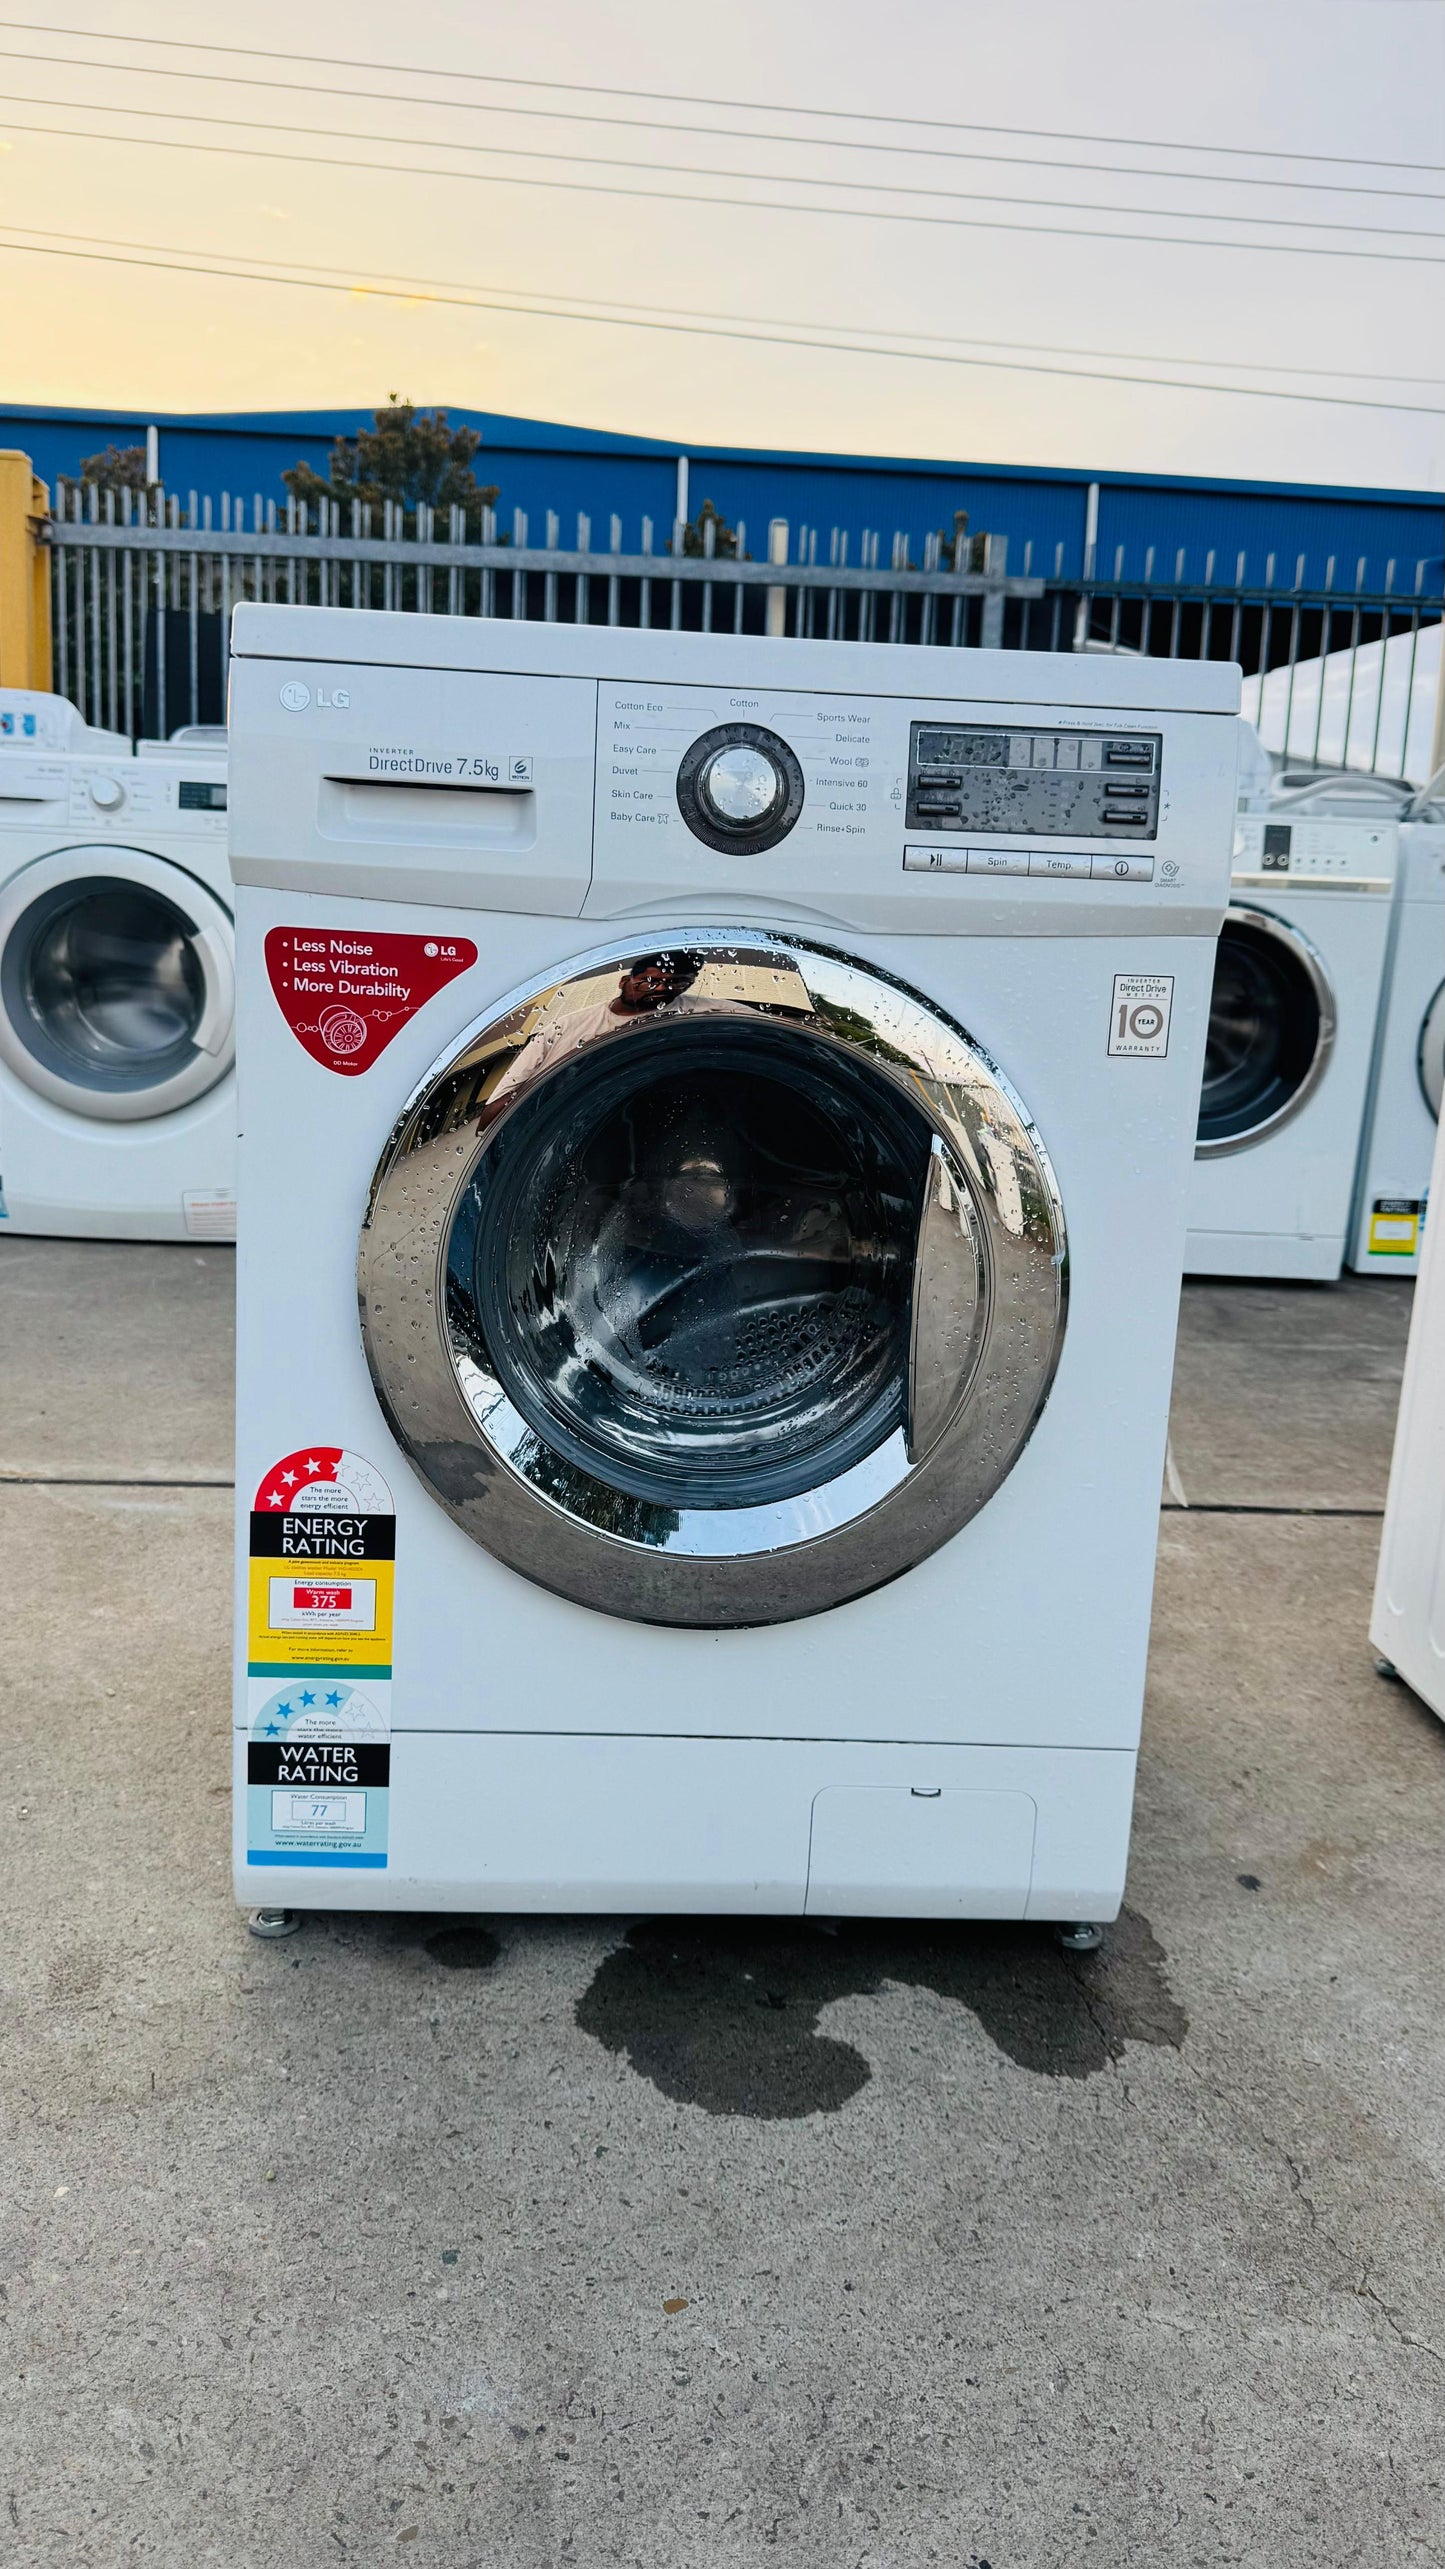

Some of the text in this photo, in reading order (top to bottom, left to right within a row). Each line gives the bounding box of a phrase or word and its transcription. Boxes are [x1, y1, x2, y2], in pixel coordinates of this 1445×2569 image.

[317, 688, 350, 709] LG
[730, 699, 758, 708] Cotton
[615, 702, 663, 711] Cotton Eco
[817, 713, 870, 724] Sports Wear
[614, 721, 630, 729] Mix
[835, 734, 870, 743] Delicate
[613, 744, 657, 755] Easy Care
[830, 757, 852, 766] Wool
[457, 758, 499, 781] 7.5kg
[612, 766, 638, 775] Duvet
[816, 778, 867, 788] Intensive 60
[612, 790, 653, 800] Skin Care
[829, 802, 866, 812] Quick 30
[611, 813, 655, 823] Baby Care
[817, 824, 865, 834] Rinse+Spin
[988, 857, 1007, 868] Spin
[1046, 859, 1073, 871] Temp.
[294, 938, 373, 955] Less Noise
[441, 945, 456, 956] LG
[294, 958, 398, 977] Less Vibration
[294, 978, 410, 1001] More Durability
[1120, 984, 1166, 993] Direct Drive
[1119, 1005, 1163, 1039] 10
[283, 1518, 368, 1535] ENERGY
[282, 1538, 365, 1556] RATING
[311, 1596, 337, 1608] 375
[280, 1746, 357, 1763] WATER
[278, 1765, 359, 1781] RATING
[312, 1805, 328, 1816] 77
[275, 1840, 362, 1848] www.waterrating.gov.au
